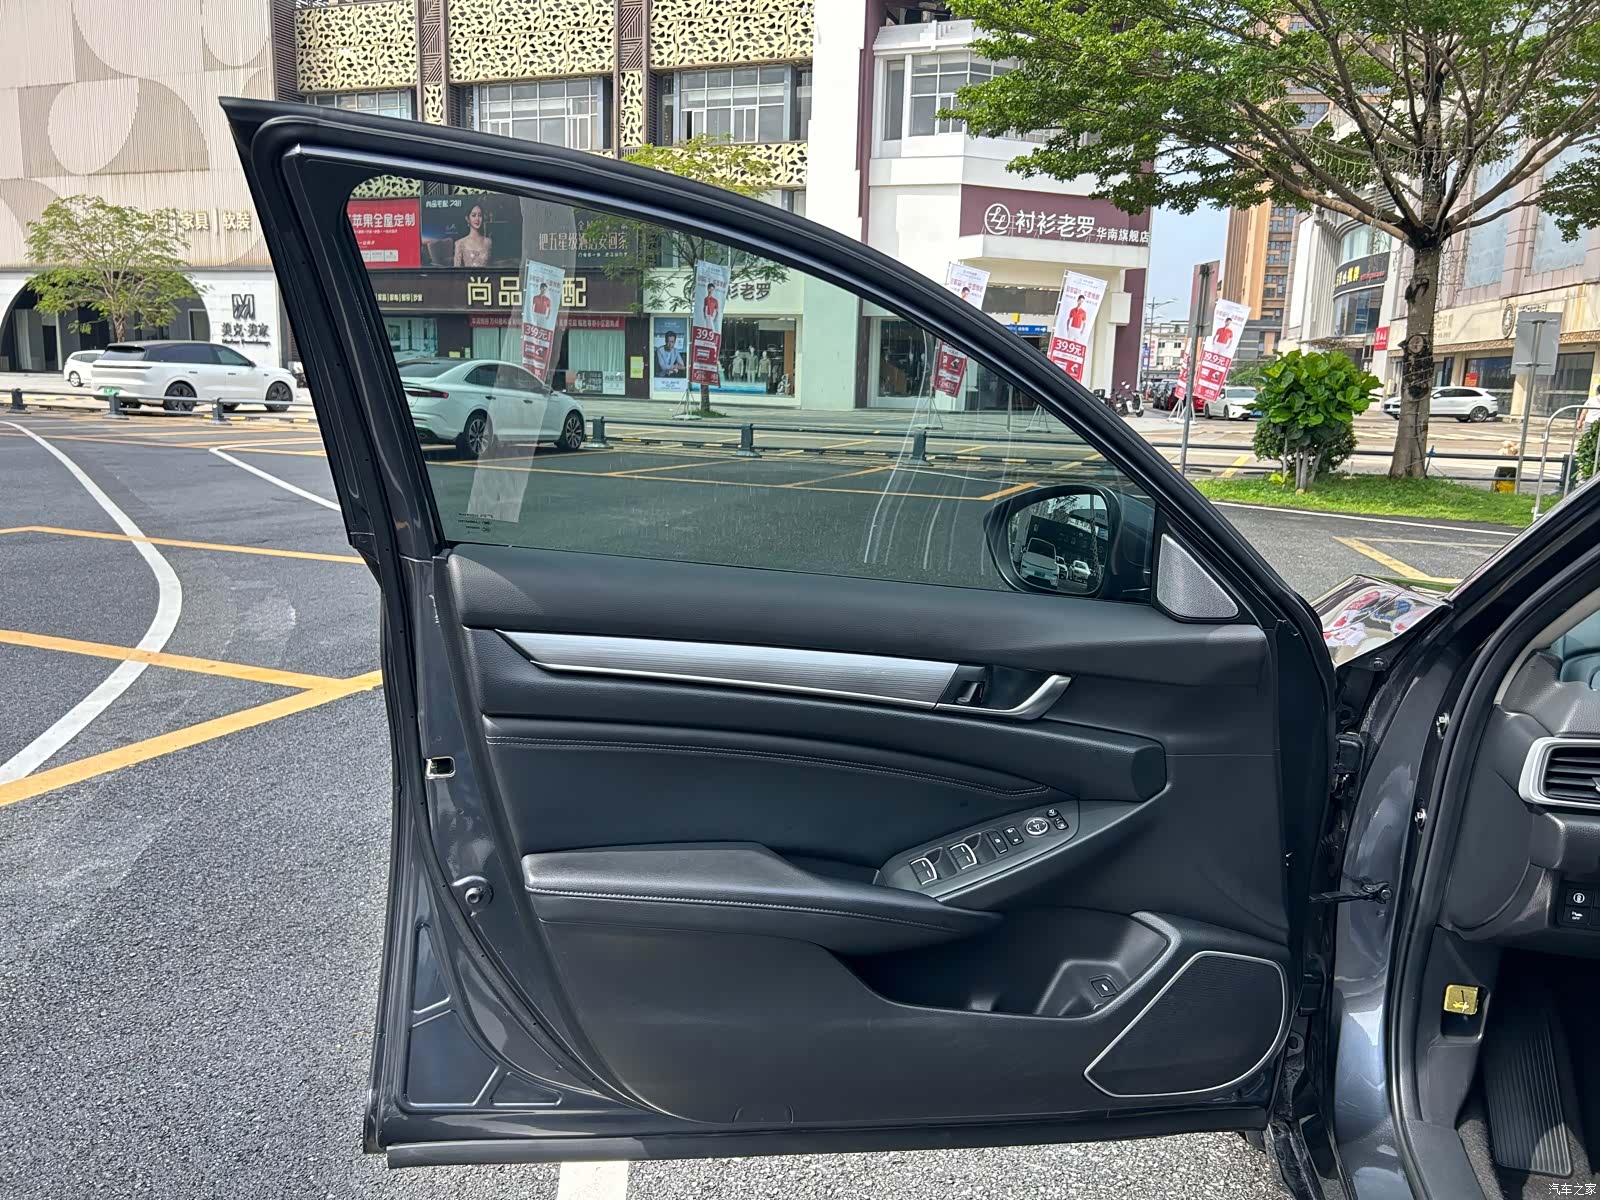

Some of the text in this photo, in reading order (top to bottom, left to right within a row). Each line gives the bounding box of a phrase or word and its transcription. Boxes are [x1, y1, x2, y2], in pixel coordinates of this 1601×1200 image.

[180, 211, 209, 231] 家具
[223, 211, 251, 231] 软装
[349, 212, 416, 229] 苹果全屋定制
[1015, 209, 1096, 238] 衬衫老罗
[1097, 227, 1151, 244] 华南旗舰店
[468, 276, 587, 307] 尚品配
[696, 328, 715, 341] 39.9
[1055, 340, 1082, 356] 39.9元
